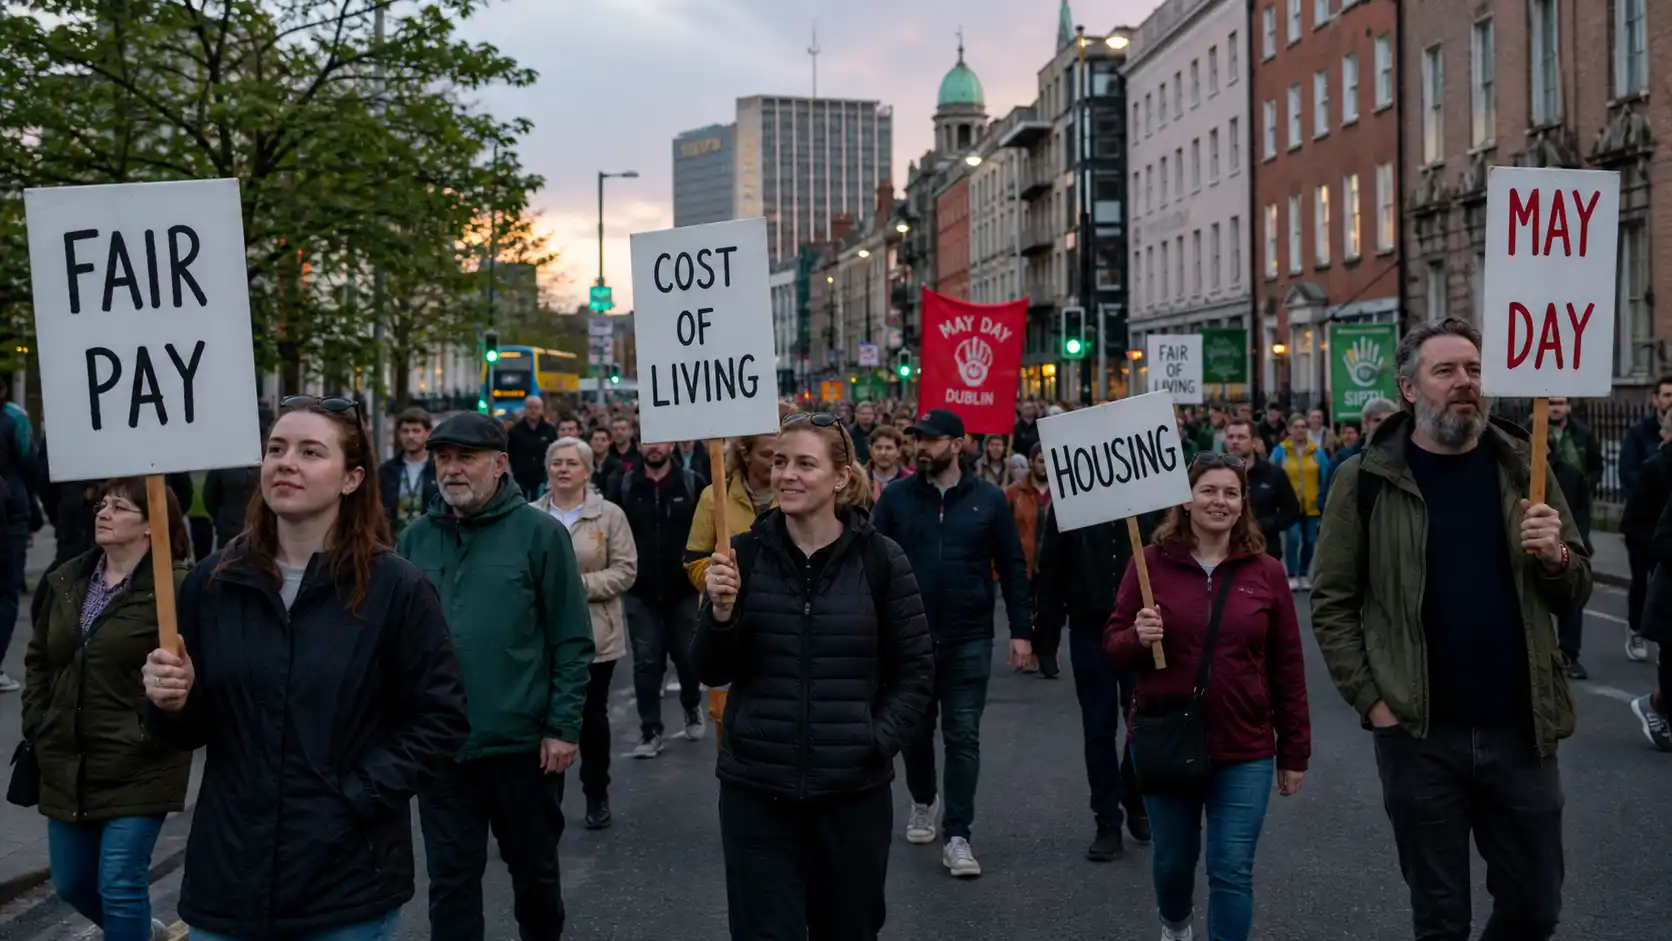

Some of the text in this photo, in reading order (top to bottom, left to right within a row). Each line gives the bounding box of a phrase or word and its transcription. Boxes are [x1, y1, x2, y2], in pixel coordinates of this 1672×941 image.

[1507, 187, 1601, 257] MAY
[63, 224, 208, 314] FAIR
[653, 245, 738, 294] COST
[676, 307, 714, 346] OF
[938, 315, 1013, 343] MAY DAY
[1506, 301, 1595, 370] DAY
[1159, 344, 1189, 361] FAIR
[1166, 363, 1184, 378] OF
[85, 340, 206, 431] PAY
[651, 353, 759, 407] LIVING
[945, 387, 994, 406] DUBLIN
[1050, 425, 1177, 499] HOUSING
